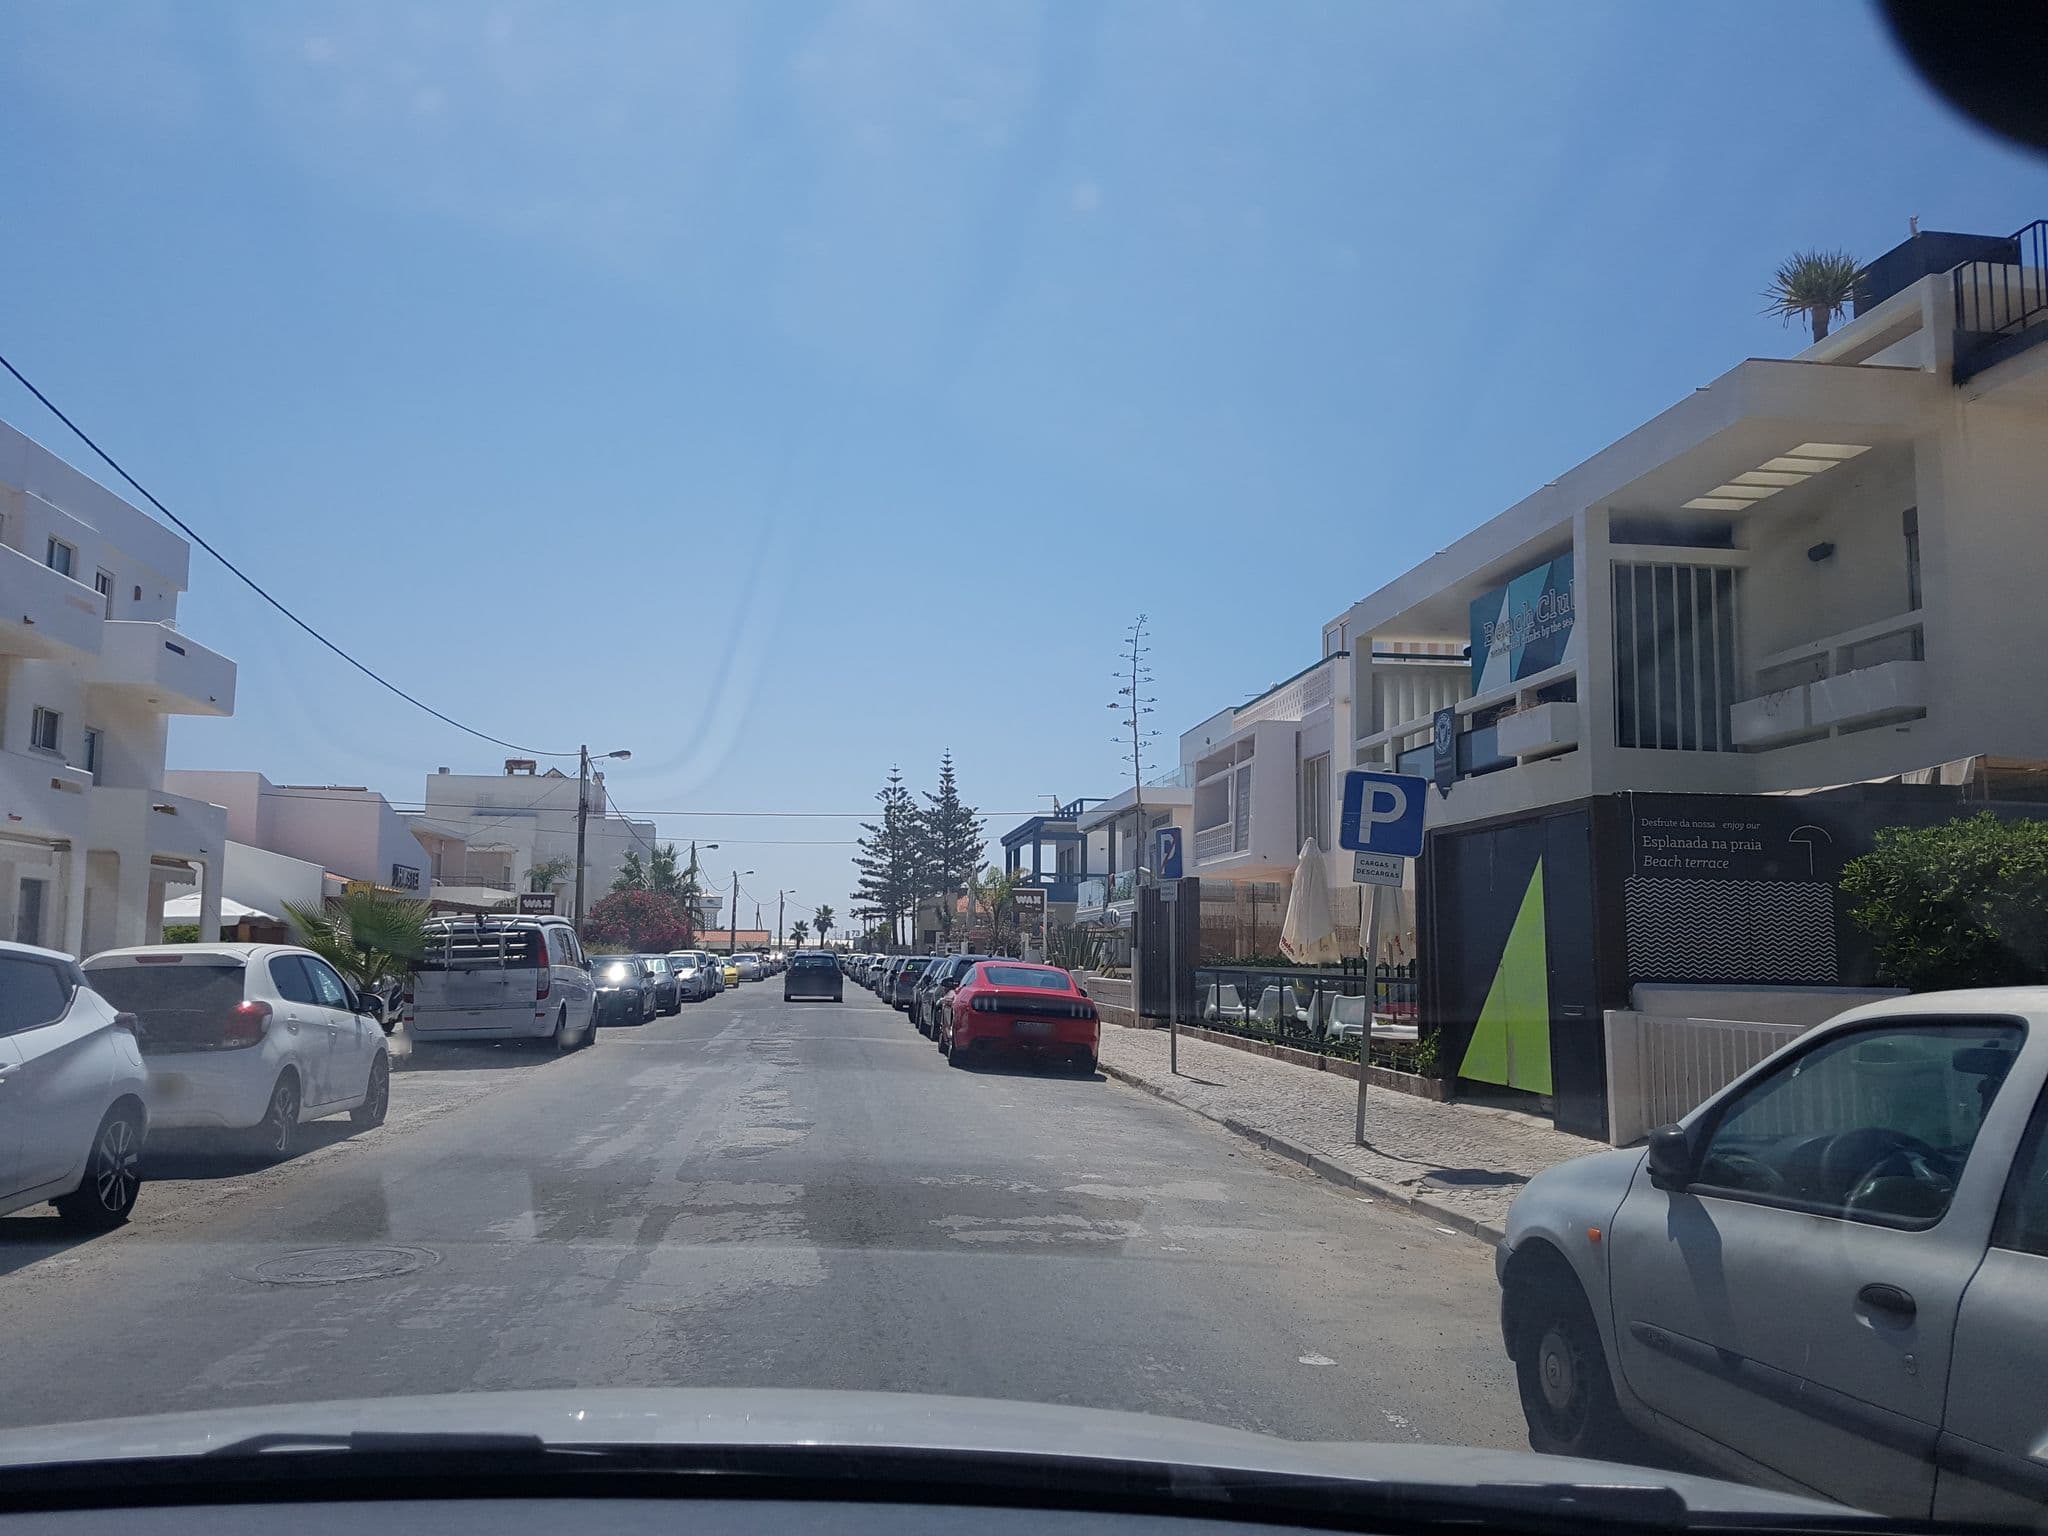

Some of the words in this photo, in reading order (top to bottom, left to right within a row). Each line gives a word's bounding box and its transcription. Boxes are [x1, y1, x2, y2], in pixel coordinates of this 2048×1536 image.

[1483, 601, 1535, 647] Beach
[1541, 625, 1550, 639] by
[1358, 780, 1407, 844] P
[1641, 818, 1678, 828] Desfrute
[1679, 819, 1690, 828] da
[1692, 821, 1716, 829] nossa
[1722, 821, 1744, 831] enjoy
[1746, 822, 1761, 830] our
[1642, 835, 1708, 851] Esplanada
[1712, 840, 1727, 850] na
[1730, 839, 1762, 853] praia
[1160, 833, 1176, 875] P
[1360, 859, 1389, 869] CARGAS
[1643, 855, 1682, 868] Beach
[1685, 857, 1729, 869] terrace
[1356, 868, 1400, 879] DESCARGAS
[522, 899, 552, 908] WAX
[1015, 895, 1041, 905] WAX
